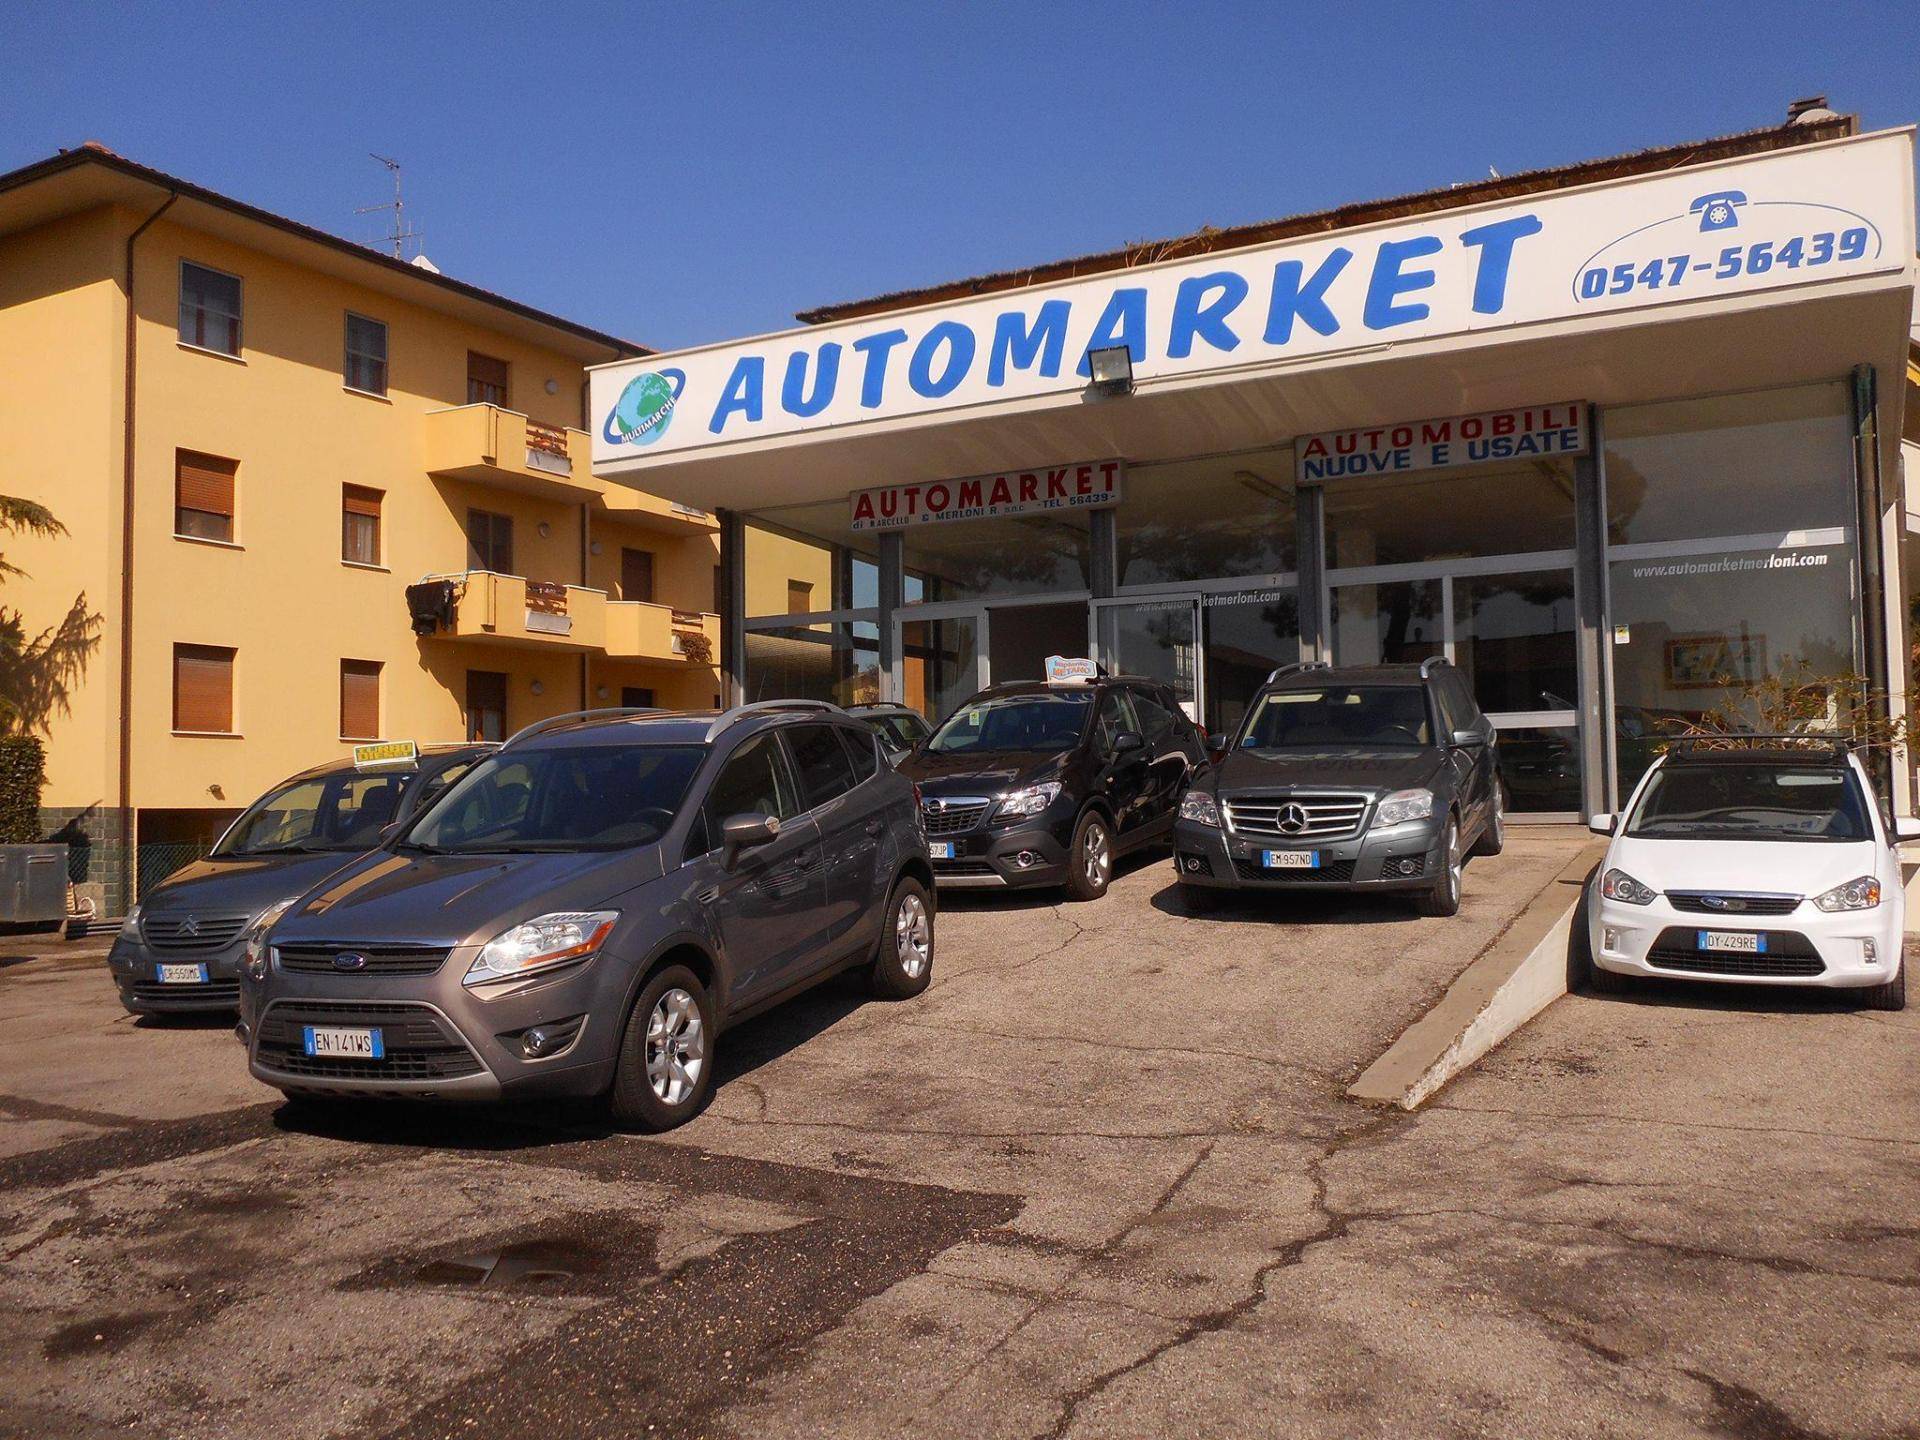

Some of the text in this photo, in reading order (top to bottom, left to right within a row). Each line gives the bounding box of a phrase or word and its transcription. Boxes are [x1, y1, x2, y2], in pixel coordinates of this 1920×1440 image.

[1581, 228, 1867, 298] 0547-56439
[710, 215, 1542, 433] AUTOMARKET
[1303, 406, 1578, 459] AUTOMOBILI
[1304, 428, 1579, 479] NUOVE E USATE
[853, 463, 1119, 521] AUTOMARKET
[853, 521, 863, 529] di
[936, 507, 985, 521] MERLONI
[1633, 552, 1828, 578] www.automarketmerloni.com
